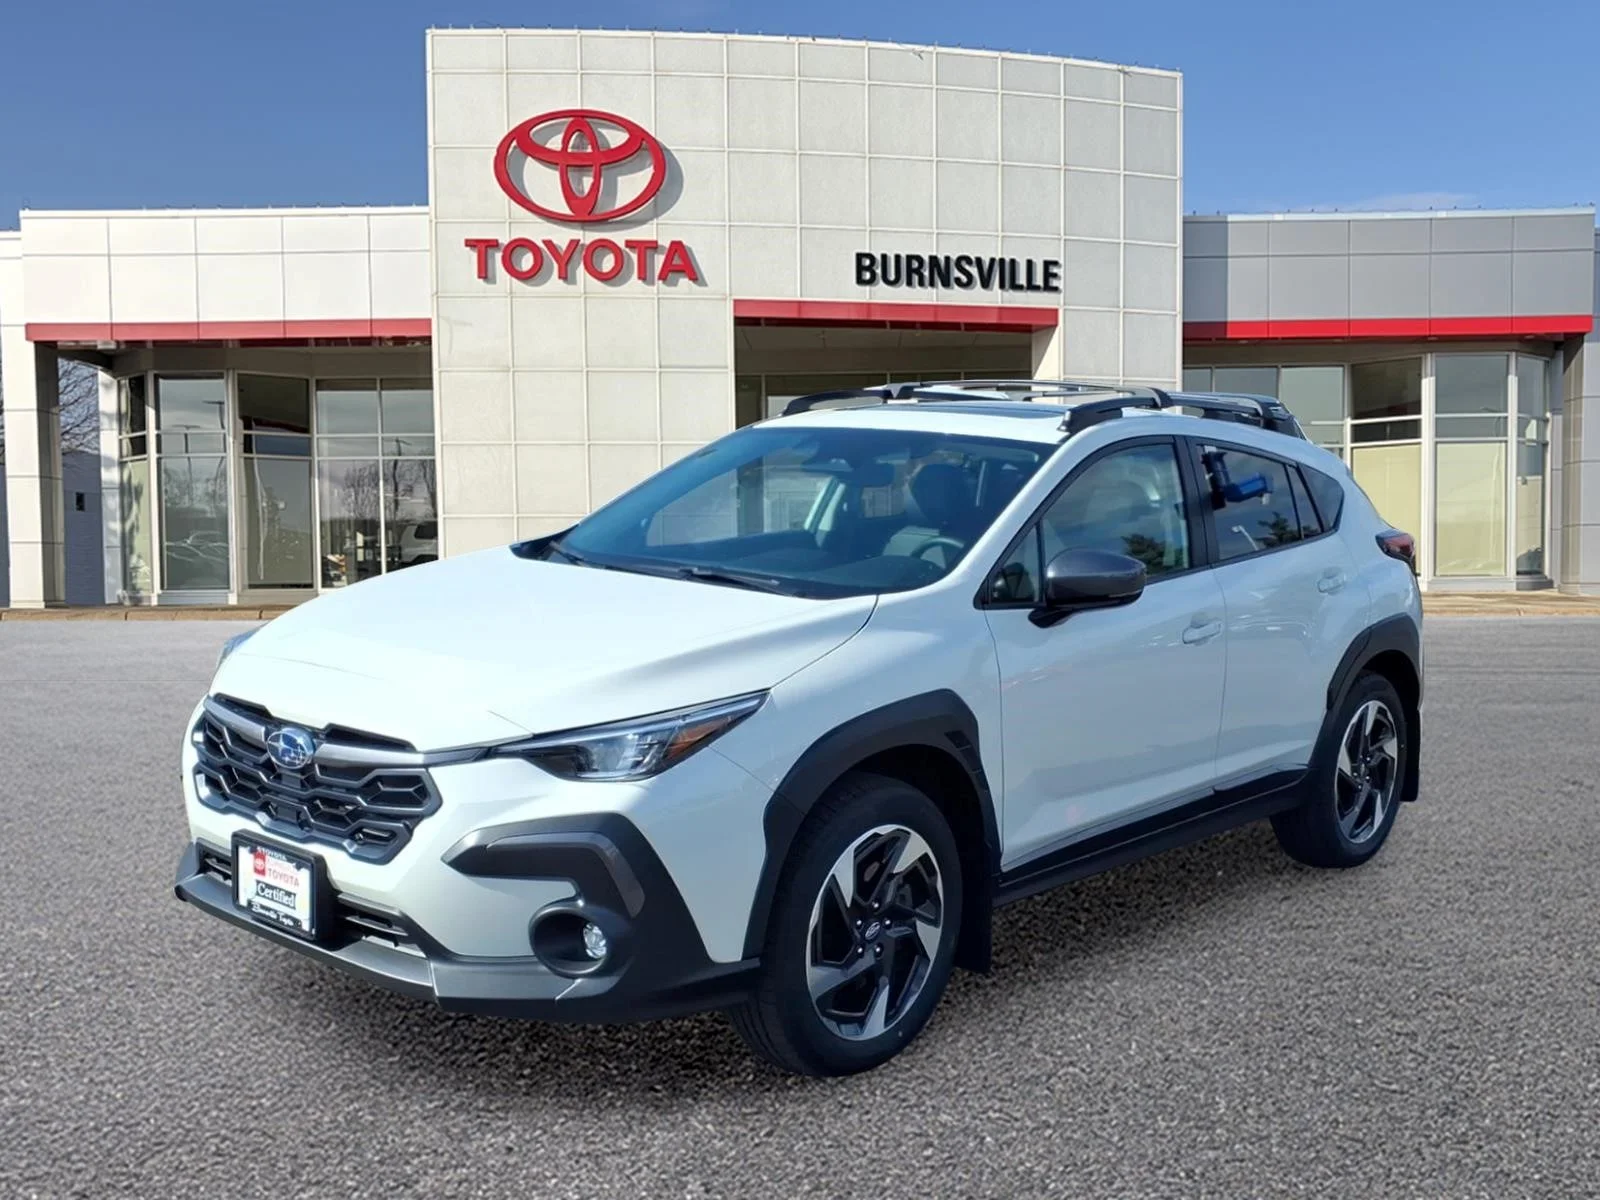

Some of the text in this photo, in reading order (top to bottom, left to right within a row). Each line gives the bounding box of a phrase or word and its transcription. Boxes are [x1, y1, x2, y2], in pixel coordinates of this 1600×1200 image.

[465, 238, 699, 282] TOYOTA
[855, 252, 1061, 292] BURNSVILLE
[267, 868, 300, 887] TOYOTA
[257, 882, 295, 908] Certified
